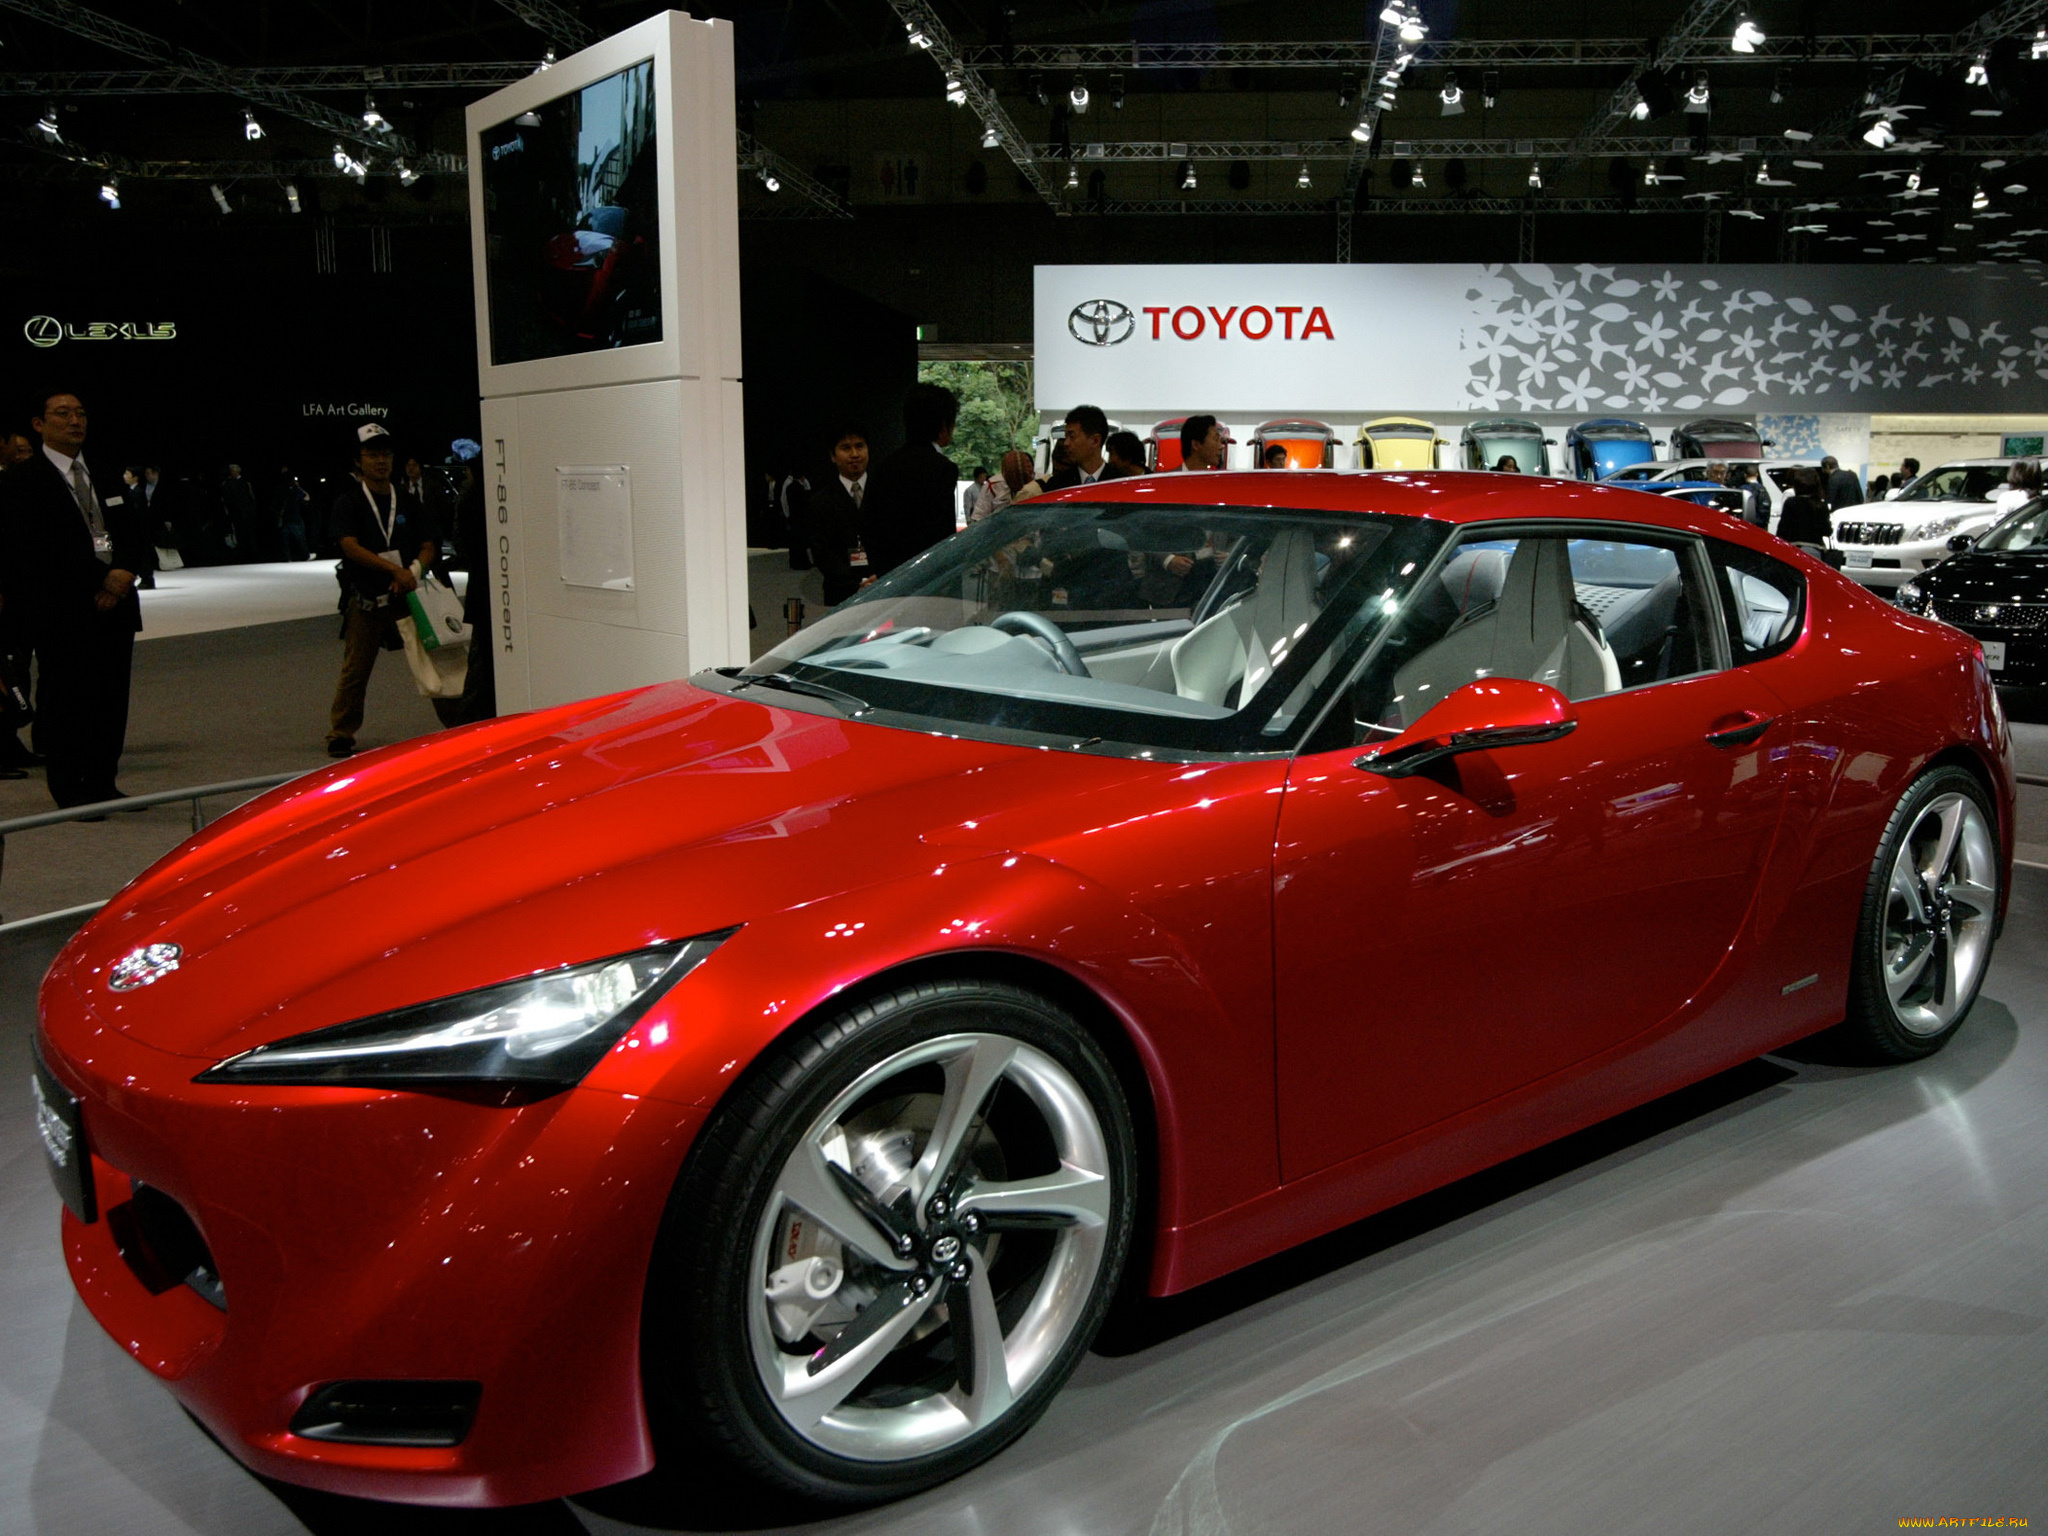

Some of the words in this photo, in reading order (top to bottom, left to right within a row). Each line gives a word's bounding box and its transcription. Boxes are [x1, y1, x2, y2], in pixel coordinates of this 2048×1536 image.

[64, 322, 177, 340] LEXUS
[1142, 305, 1335, 340] TOYOTA
[302, 403, 324, 416] LFA
[327, 403, 345, 416] Art
[347, 403, 389, 418] Gallery
[494, 438, 508, 524] FT-86
[499, 535, 514, 653] Concept
